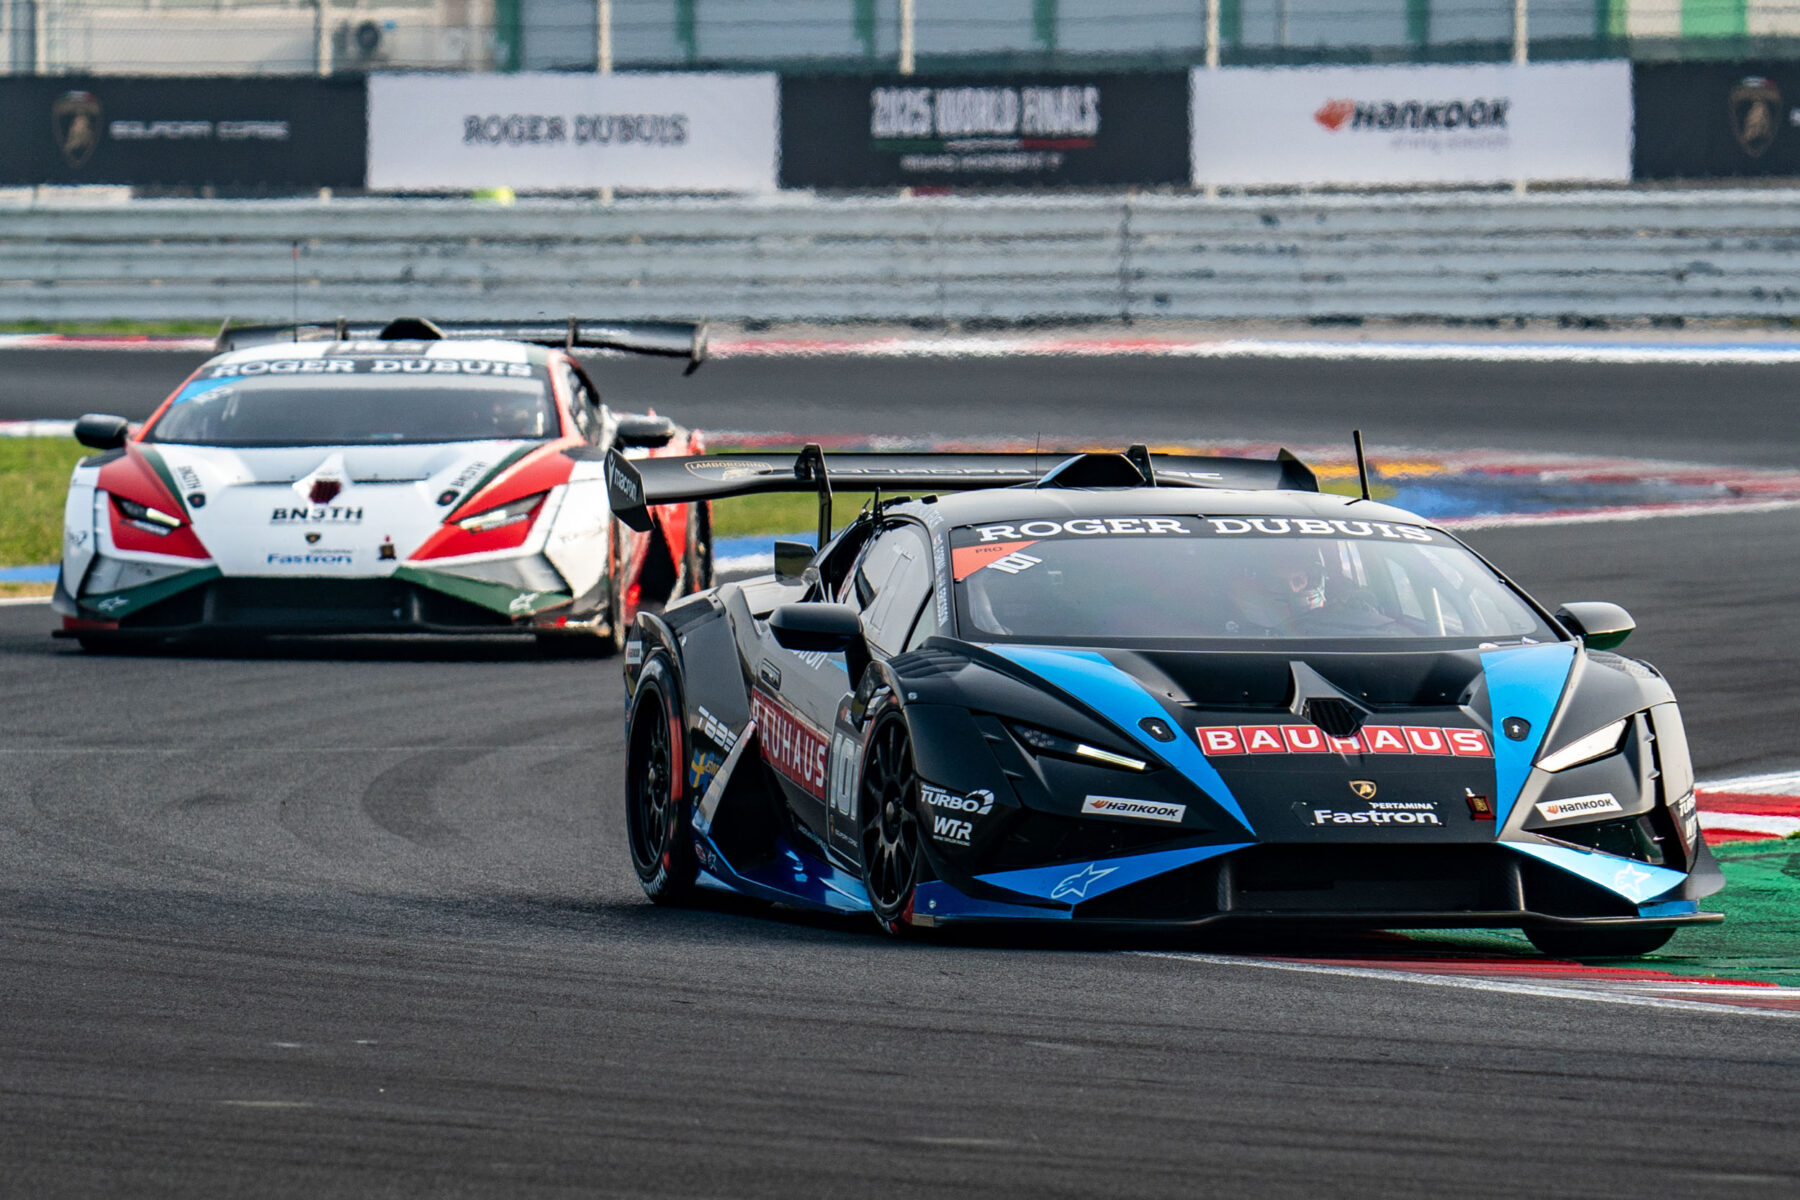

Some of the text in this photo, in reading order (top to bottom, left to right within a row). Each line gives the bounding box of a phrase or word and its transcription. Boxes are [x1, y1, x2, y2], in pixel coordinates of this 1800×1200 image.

[464, 115, 688, 145] ROGER DUBUIS
[211, 358, 532, 378] ROGER DUBUIS
[976, 518, 1433, 542] ROGER DUBUIS
[267, 553, 352, 564] Fastron
[975, 546, 1003, 554] PRO
[986, 551, 1043, 575] 101
[1204, 729, 1485, 752] BAUHAUS
[1313, 809, 1439, 824] Fastron
[1371, 802, 1435, 810] PERTAMINA
[933, 815, 973, 841] WTR
